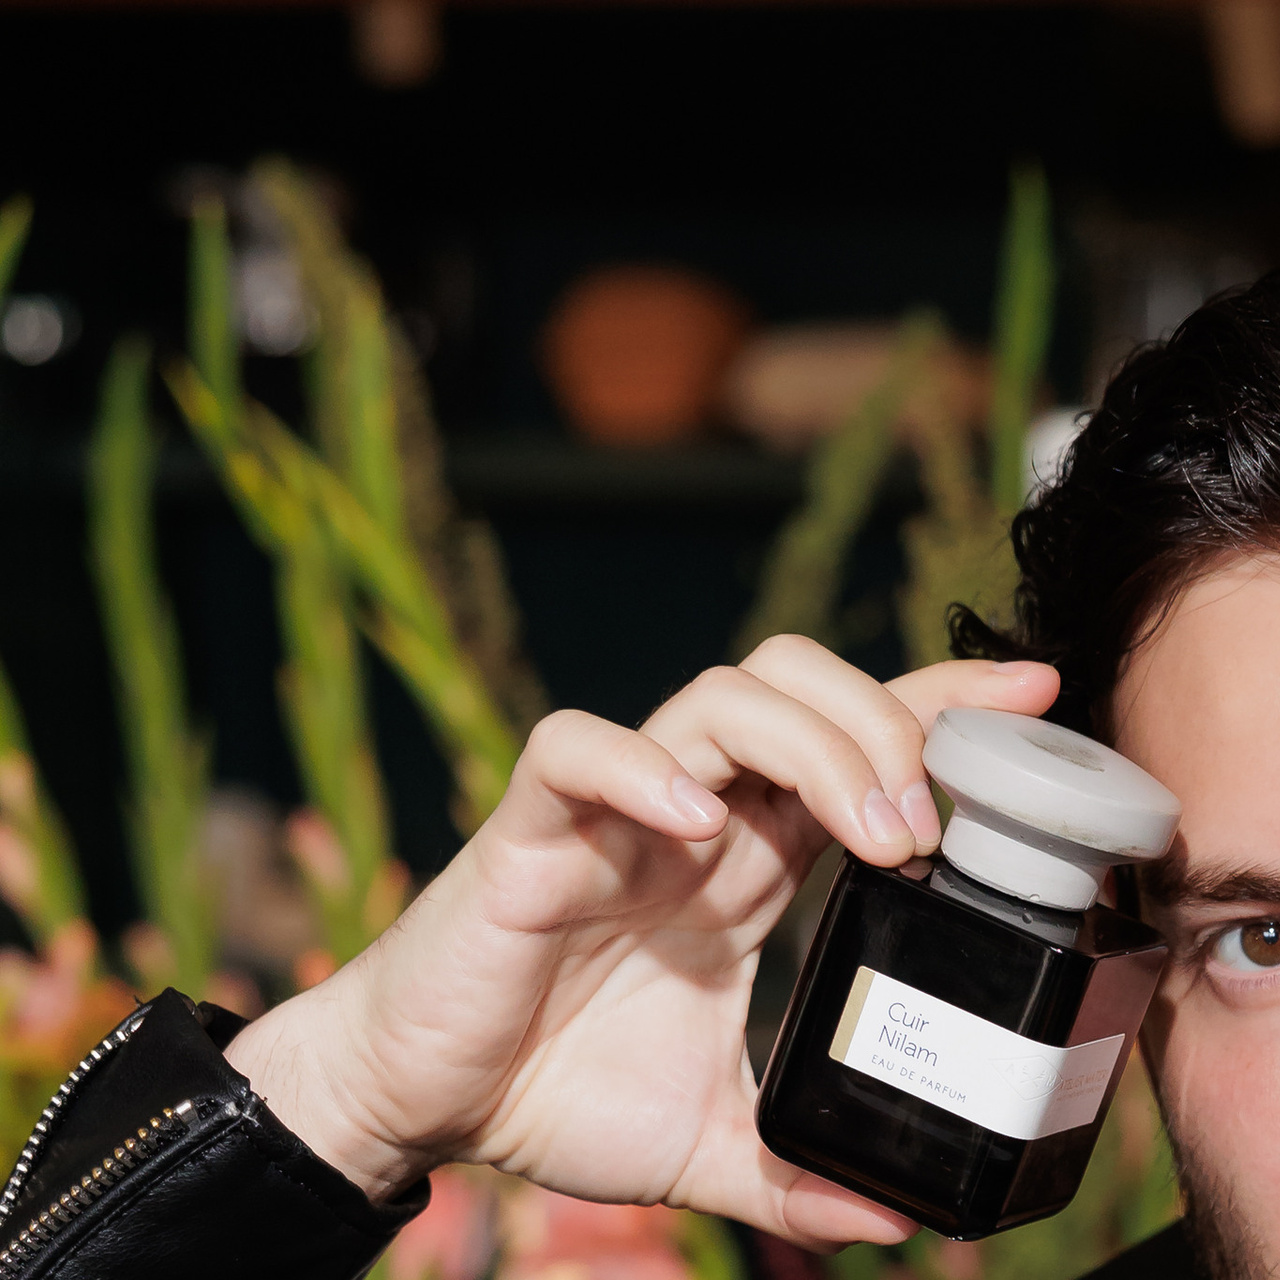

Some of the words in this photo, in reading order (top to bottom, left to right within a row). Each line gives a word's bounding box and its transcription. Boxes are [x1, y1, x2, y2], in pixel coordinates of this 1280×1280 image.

[888, 1002, 930, 1032] Cuir
[878, 1024, 938, 1067] Nilam
[871, 1054, 895, 1071] EAU
[899, 1066, 916, 1081] DE
[919, 1075, 967, 1103] PARFUM
